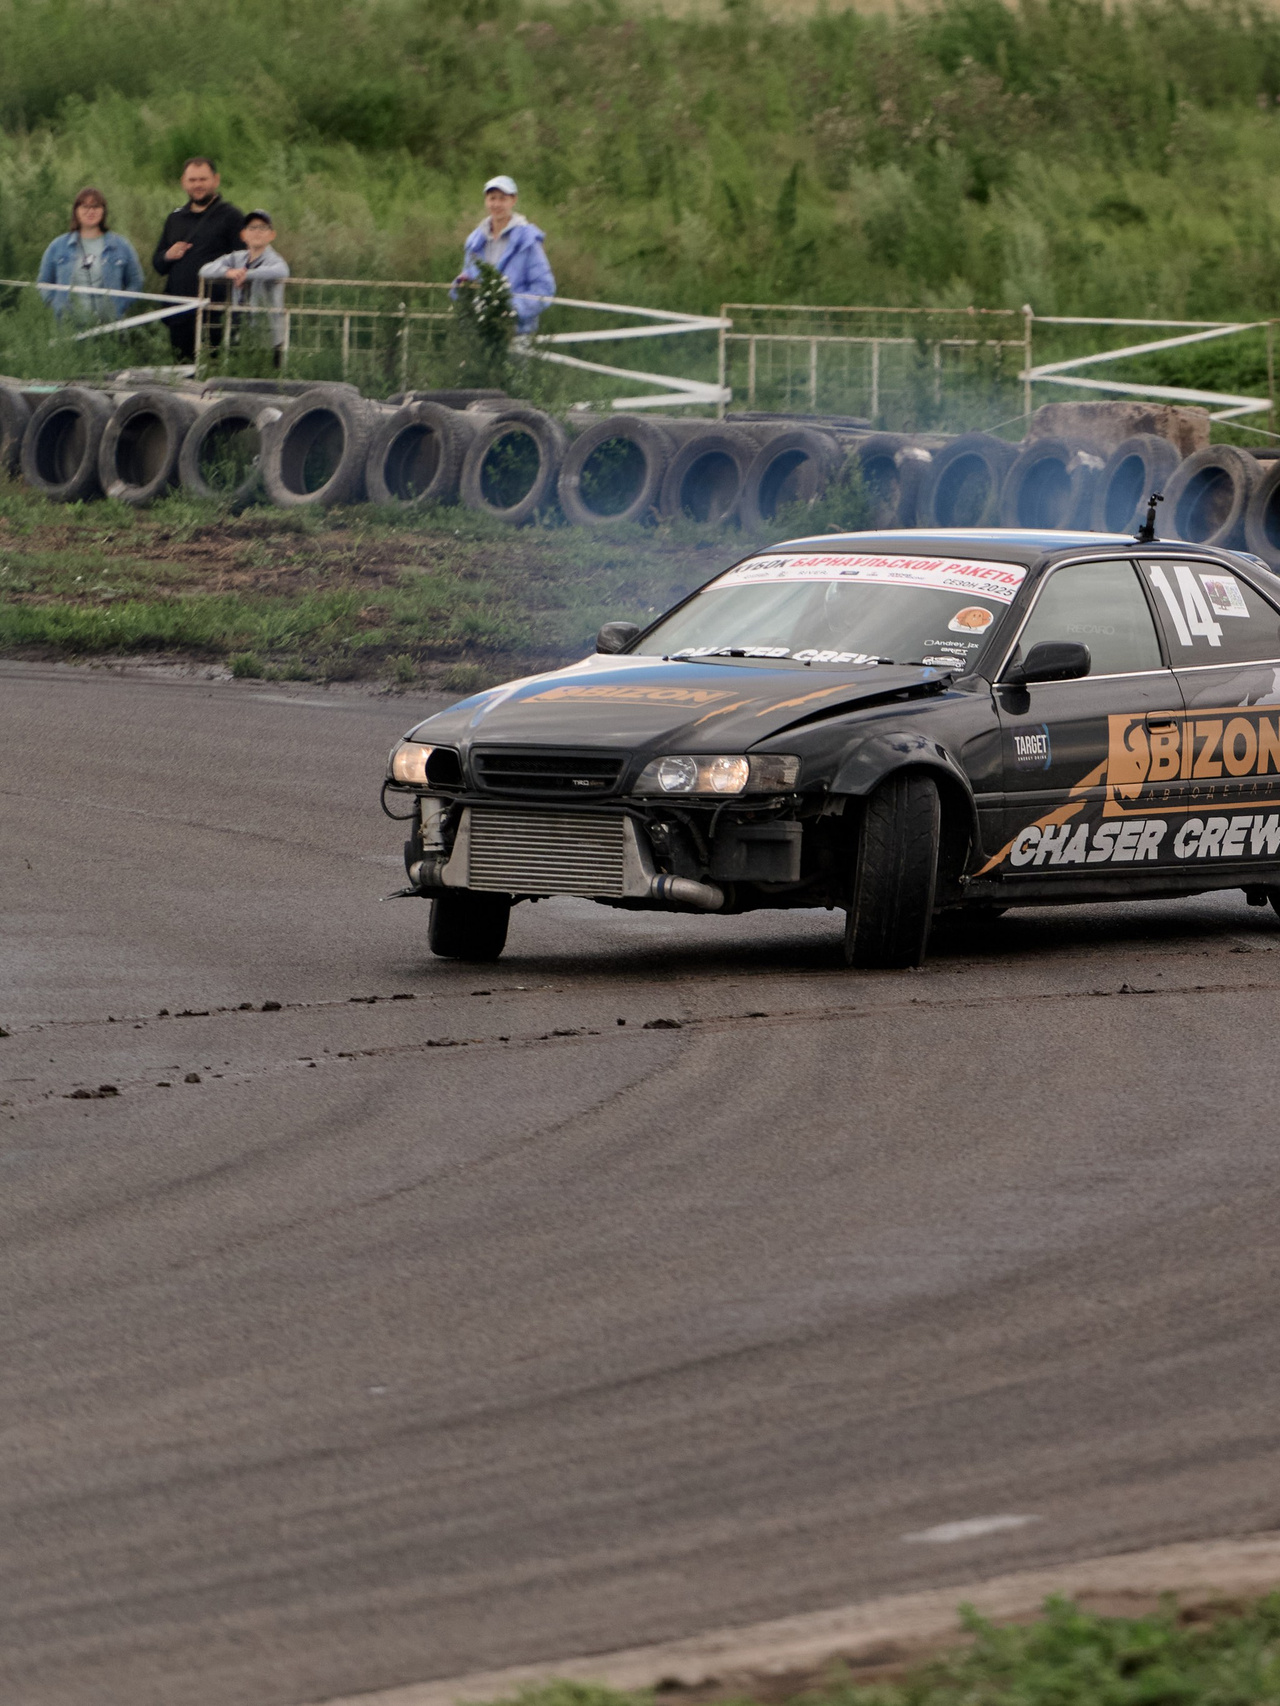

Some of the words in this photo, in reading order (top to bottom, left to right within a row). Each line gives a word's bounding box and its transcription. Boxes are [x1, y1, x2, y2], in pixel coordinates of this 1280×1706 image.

[790, 557, 943, 571] БАРНАУЛЬСКОЙ
[942, 564, 1024, 586] РАКЕТЫ
[943, 579, 978, 589] СЕЗОН
[979, 583, 1016, 597] 2025
[1149, 566, 1223, 647] 14
[1067, 624, 1115, 635] RECARO
[579, 686, 724, 703] BIZON
[1014, 735, 1047, 755] TARGET
[1010, 817, 1167, 866] CHASER
